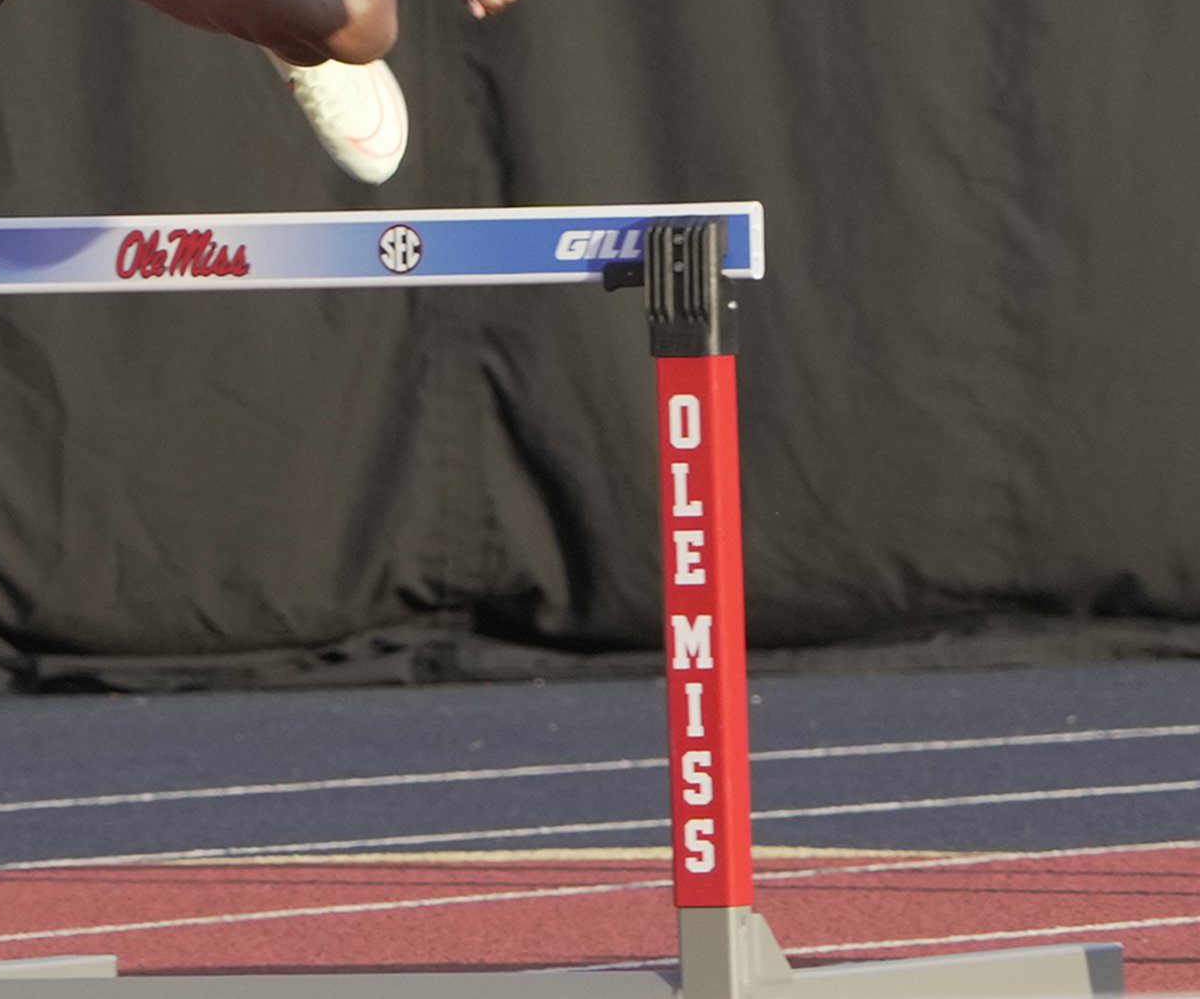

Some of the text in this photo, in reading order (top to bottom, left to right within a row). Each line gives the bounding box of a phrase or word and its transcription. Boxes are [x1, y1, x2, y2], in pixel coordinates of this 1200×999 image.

[116, 229, 251, 279] Ole Miss
[378, 224, 422, 274] SEC
[555, 230, 641, 261] GILL
[668, 394, 716, 873] OLE MISS
